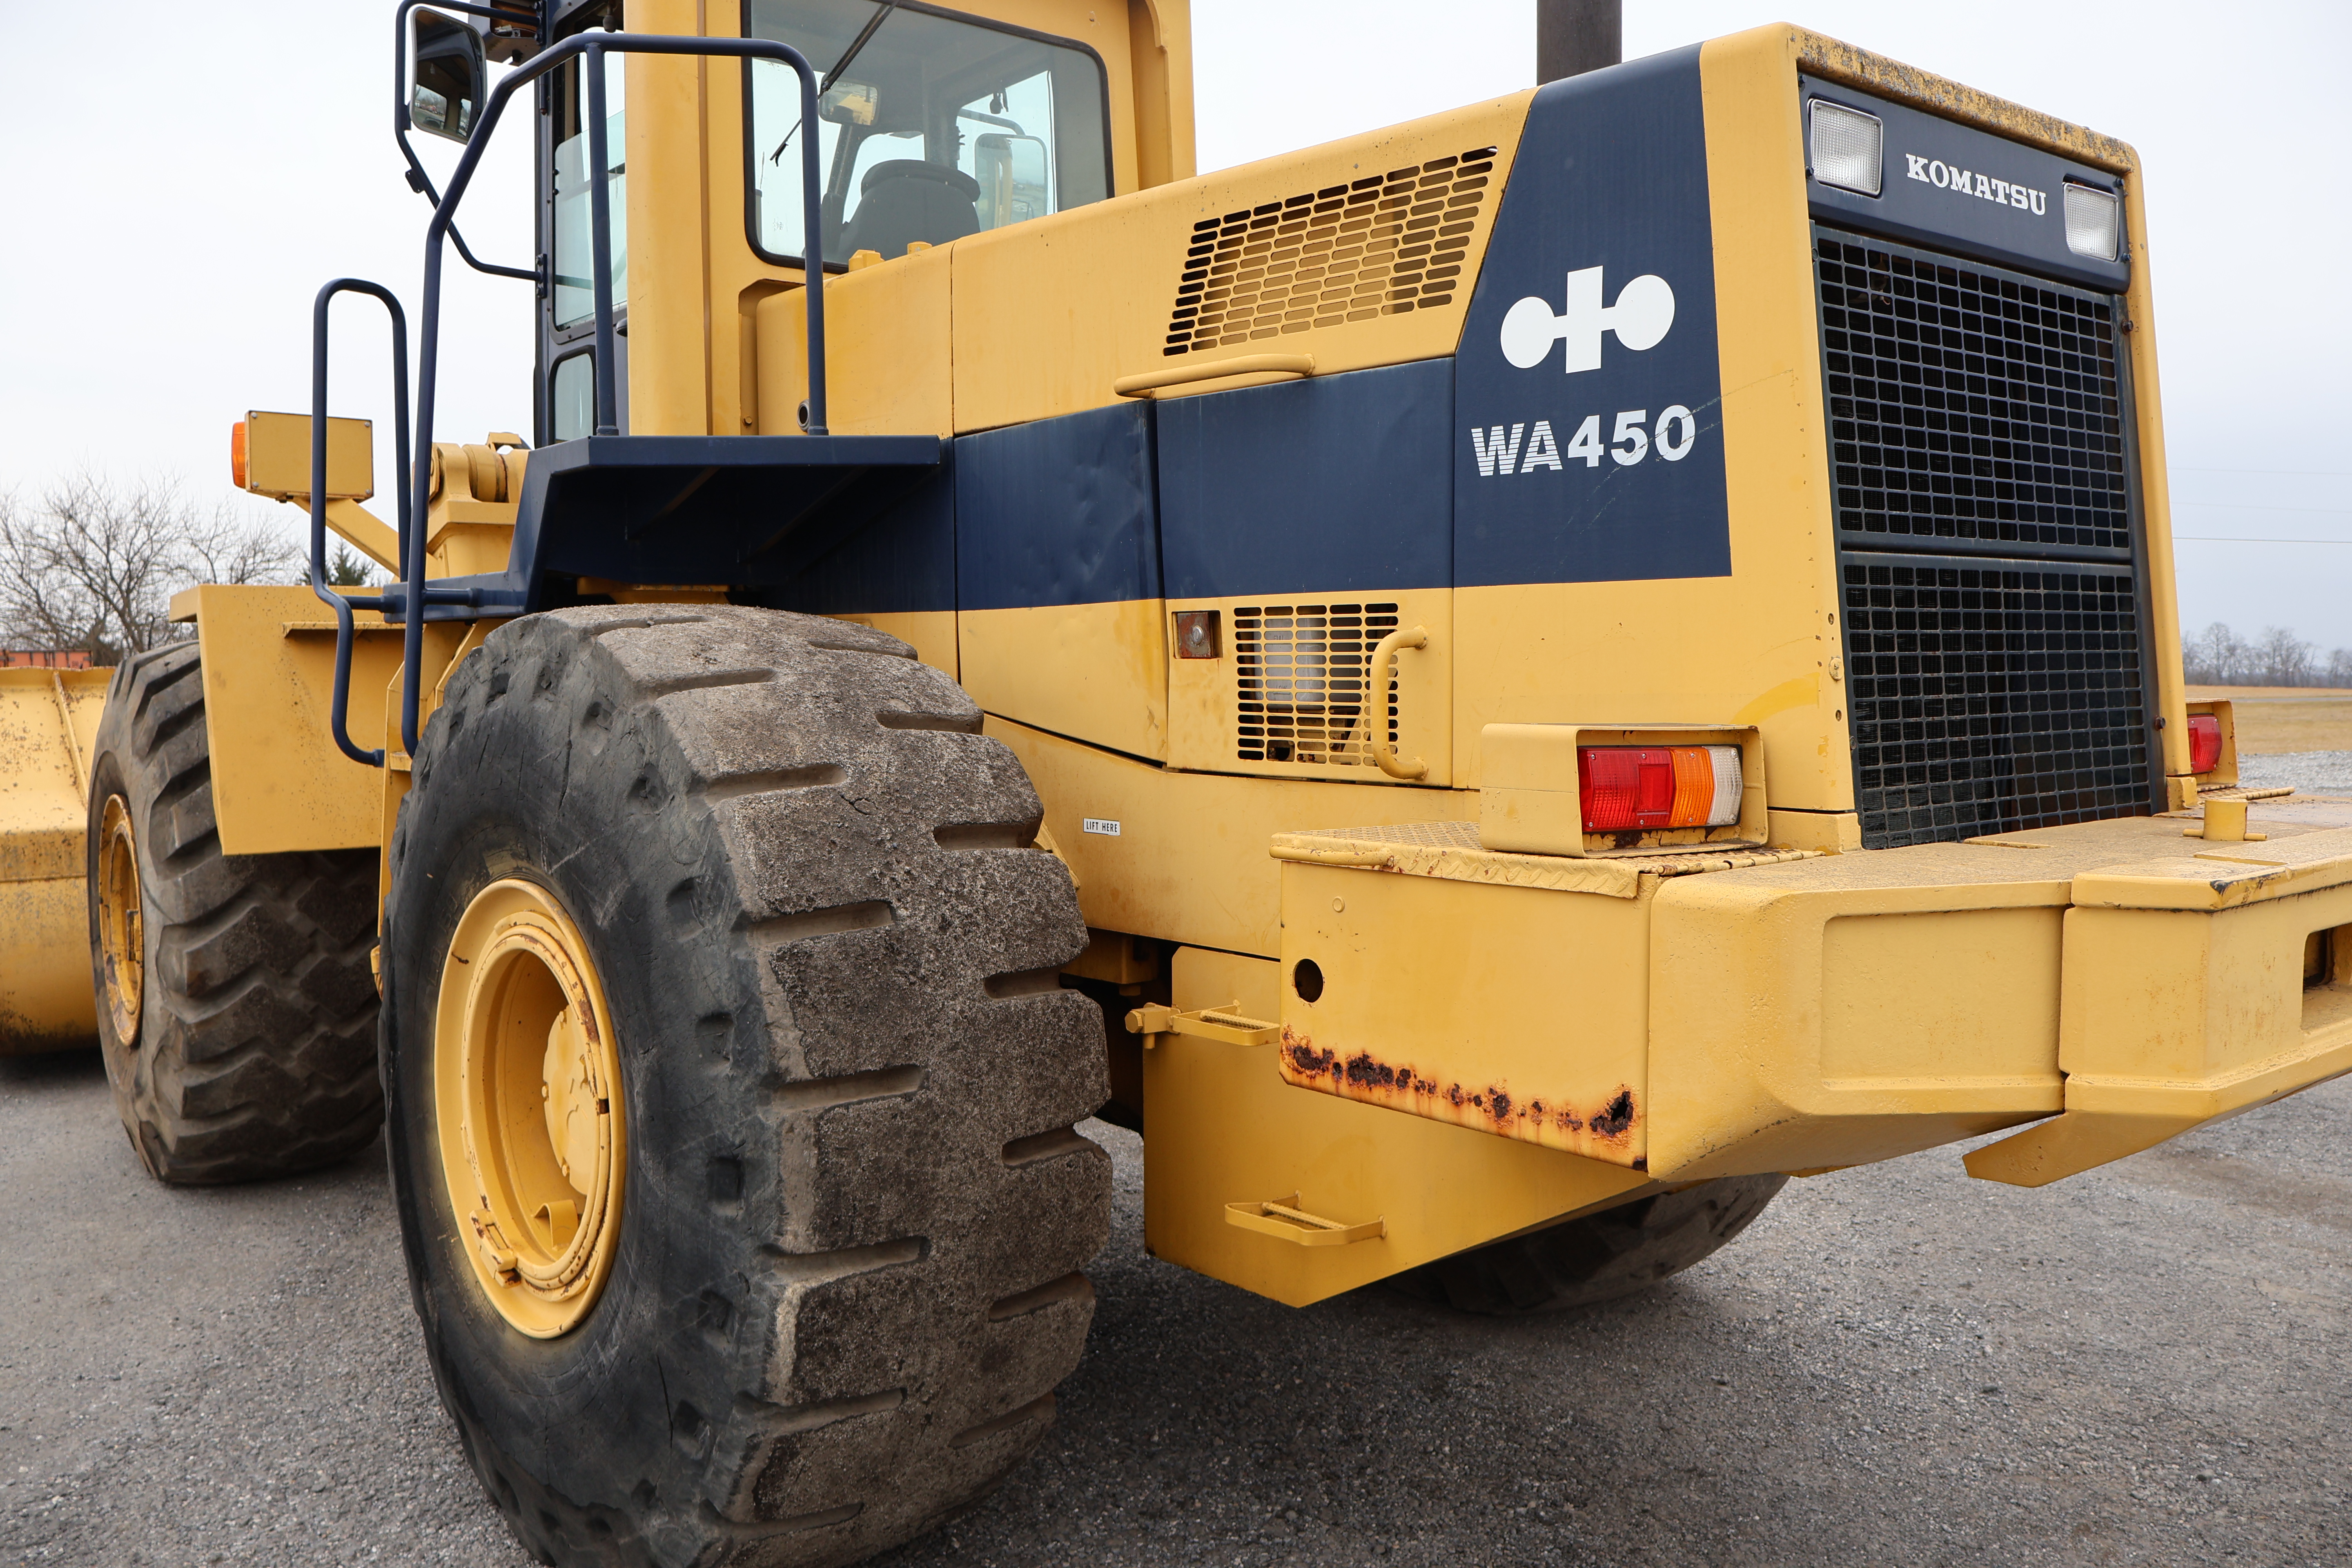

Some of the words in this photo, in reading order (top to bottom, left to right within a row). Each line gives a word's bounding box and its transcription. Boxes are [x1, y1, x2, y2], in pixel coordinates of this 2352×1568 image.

[1906, 153, 2046, 216] KOMATSU
[1471, 405, 1695, 476] WA450
[1087, 821, 1098, 830] LIFT
[1102, 822, 1117, 832] HERE
